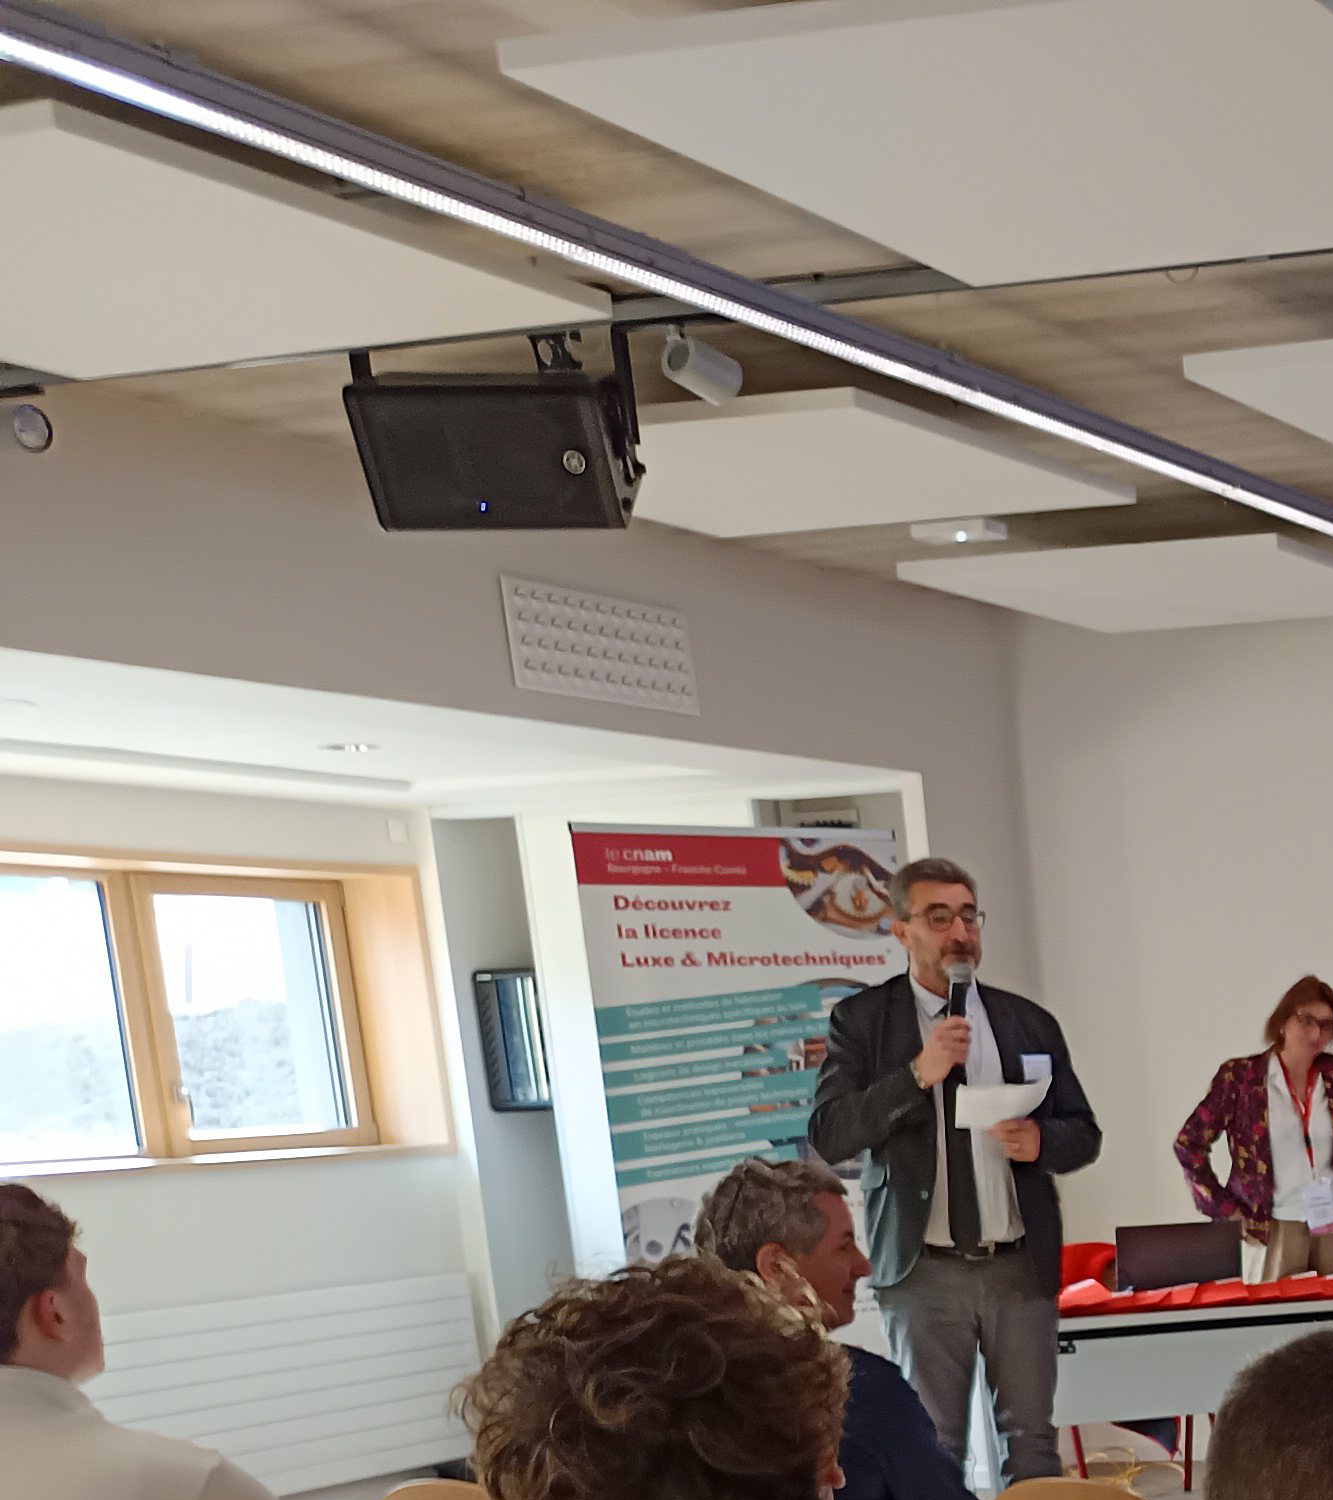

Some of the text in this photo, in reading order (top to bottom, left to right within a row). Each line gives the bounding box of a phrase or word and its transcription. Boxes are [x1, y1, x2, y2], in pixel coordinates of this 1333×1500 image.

[622, 848, 673, 862] cnam
[613, 894, 732, 912] Découvrez
[617, 923, 722, 940] la licence
[621, 950, 887, 969] Luxe & Microtechniques
